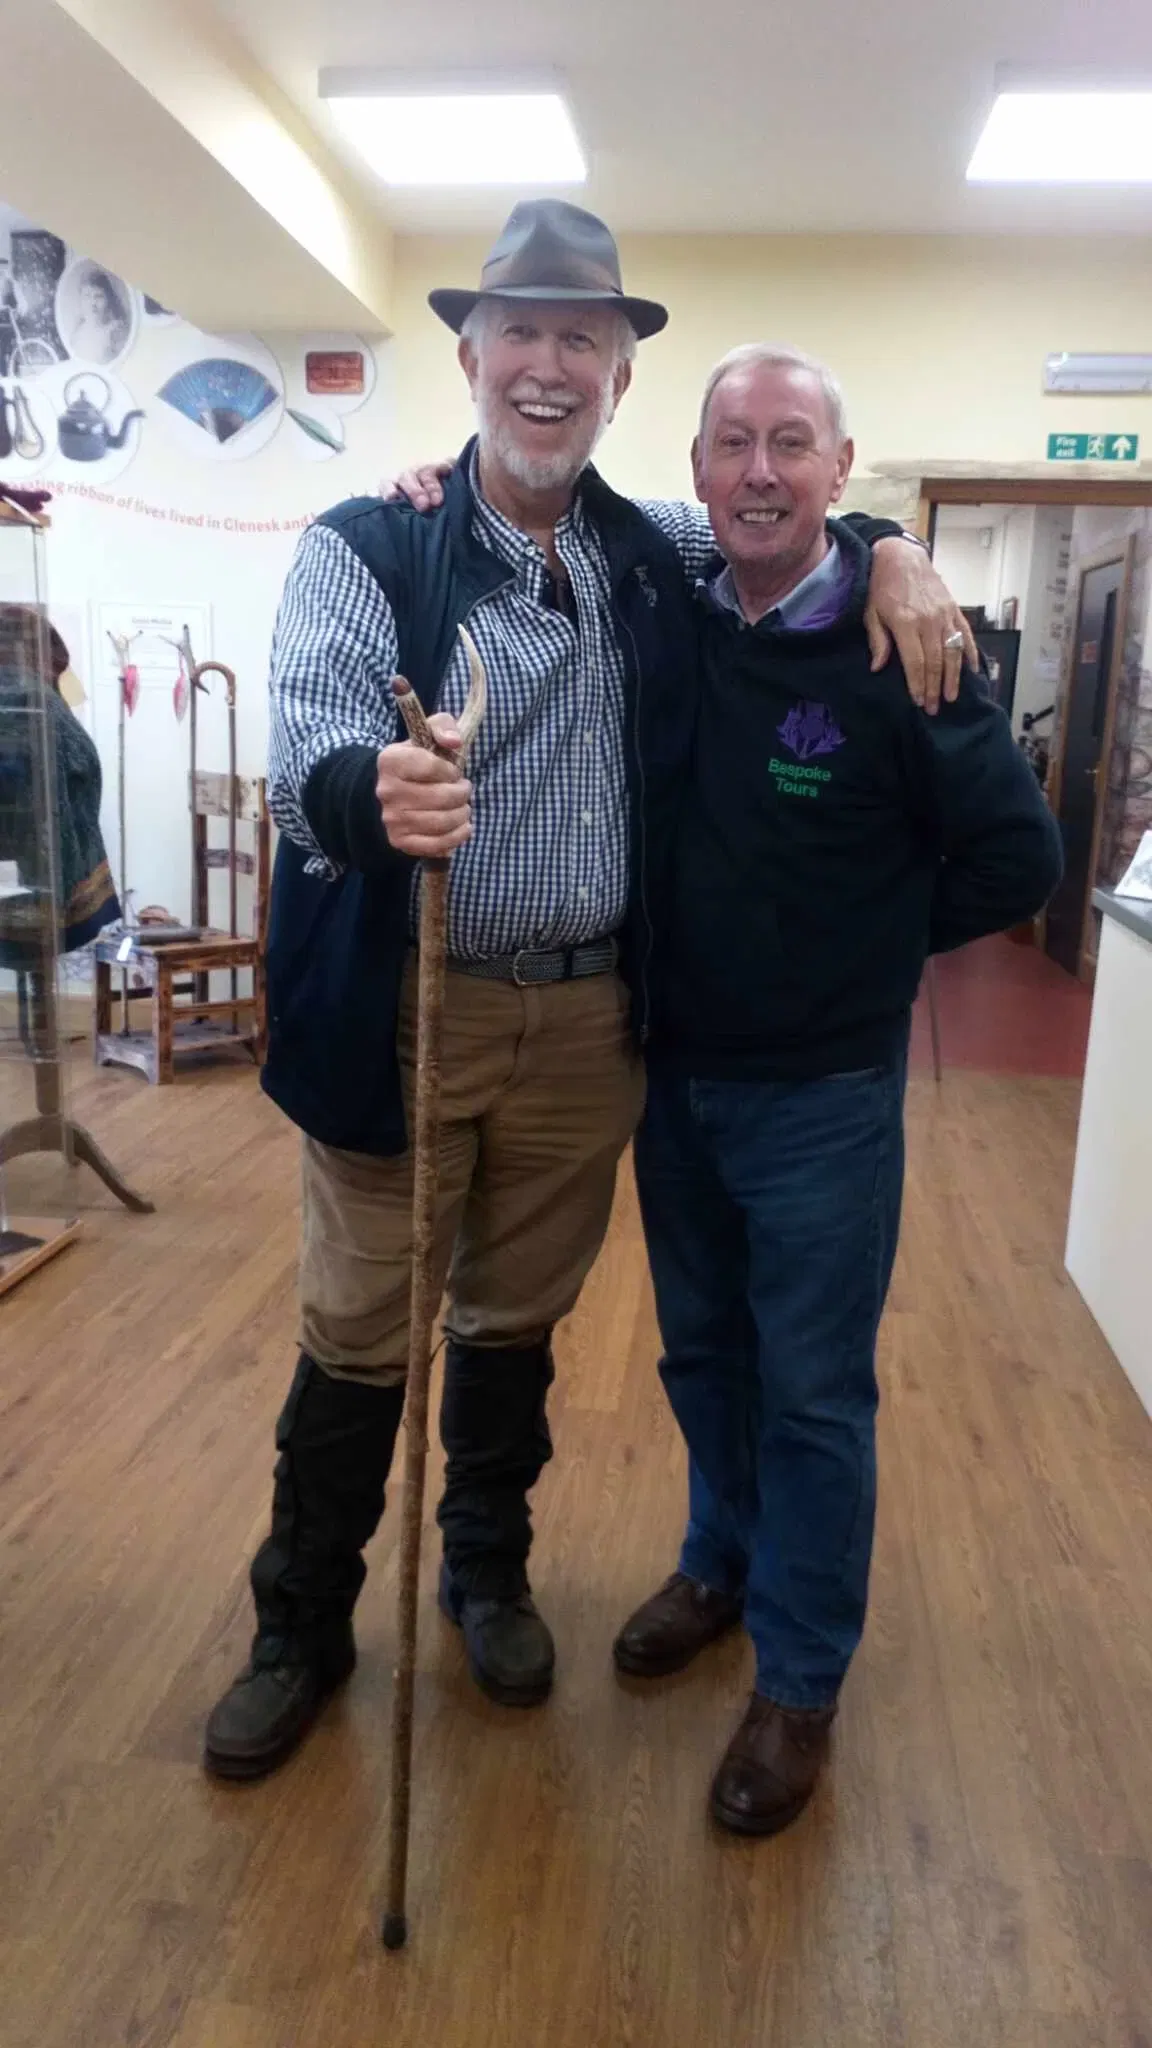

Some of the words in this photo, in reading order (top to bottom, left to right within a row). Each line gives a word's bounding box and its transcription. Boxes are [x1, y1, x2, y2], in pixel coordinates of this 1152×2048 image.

[1056, 436, 1077, 447] Fire
[68, 481, 114, 504] ribbon
[117, 496, 133, 510] of
[134, 497, 166, 520] lives
[169, 507, 205, 527] lived
[208, 514, 220, 529] in
[224, 516, 280, 533] Glenesk
[284, 514, 309, 531] and
[768, 757, 832, 782] Bespoke
[776, 776, 818, 798] Tours
